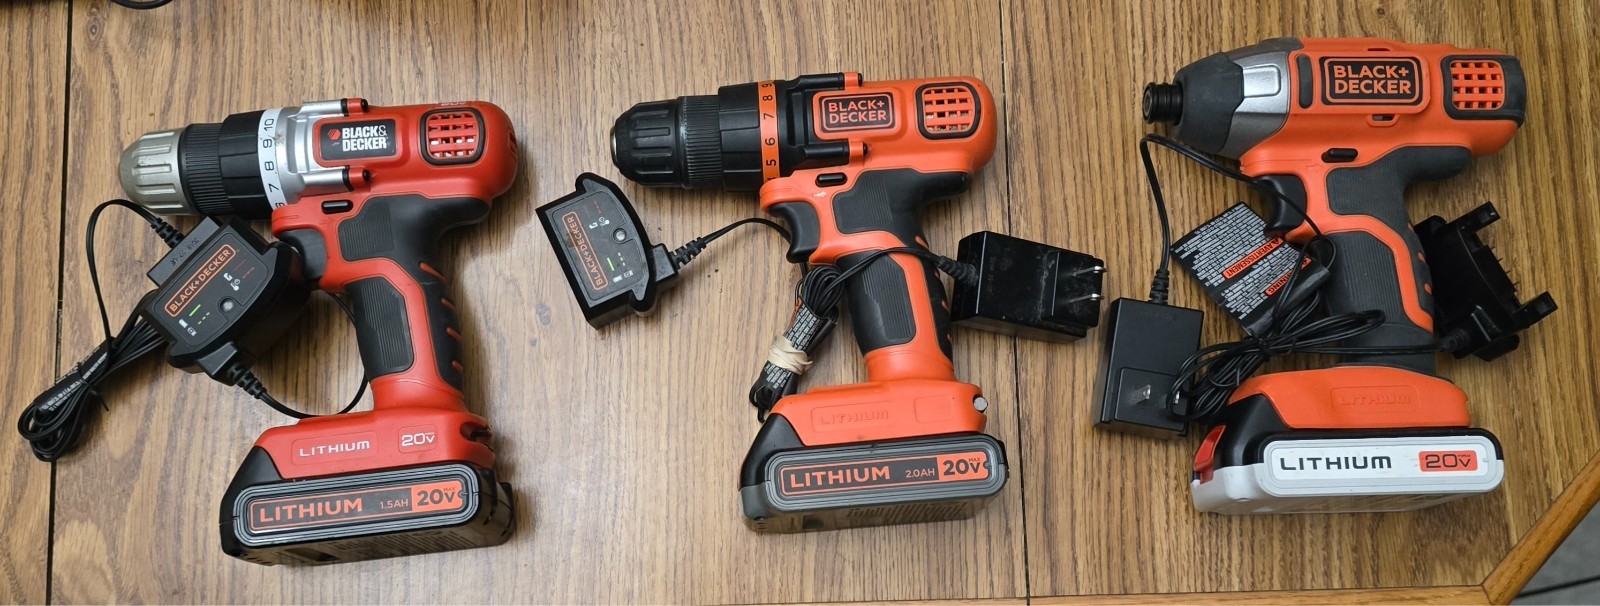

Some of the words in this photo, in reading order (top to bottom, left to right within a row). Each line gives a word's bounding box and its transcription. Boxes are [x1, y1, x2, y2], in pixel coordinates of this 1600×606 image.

[1333, 65, 1409, 78] BLACK+
[1334, 79, 1411, 94] DECKER
[762, 94, 773, 102] 8
[828, 99, 885, 113] BLACK+
[763, 112, 775, 120] 7
[829, 110, 887, 124] DECKER
[264, 118, 274, 131] 10
[342, 125, 387, 139] BLACK&
[262, 138, 272, 148] 9
[342, 137, 387, 151] DECKER
[764, 137, 775, 146] 6
[264, 160, 275, 171] 8
[766, 158, 777, 167] 5
[268, 183, 280, 193] 7
[567, 216, 604, 286] BLACK+DECKER
[1226, 242, 1275, 277] AVERTISSEMENT
[169, 249, 231, 312] BLACK+DECKER
[819, 409, 889, 425] LITHIUM
[299, 440, 371, 457] LITHIUM
[1280, 455, 1392, 471] LITHIUM
[790, 465, 890, 488] LITHIUM
[905, 468, 935, 479] 2.0AH
[259, 497, 363, 523] LITHIUM
[379, 499, 409, 510] 1.5AH
